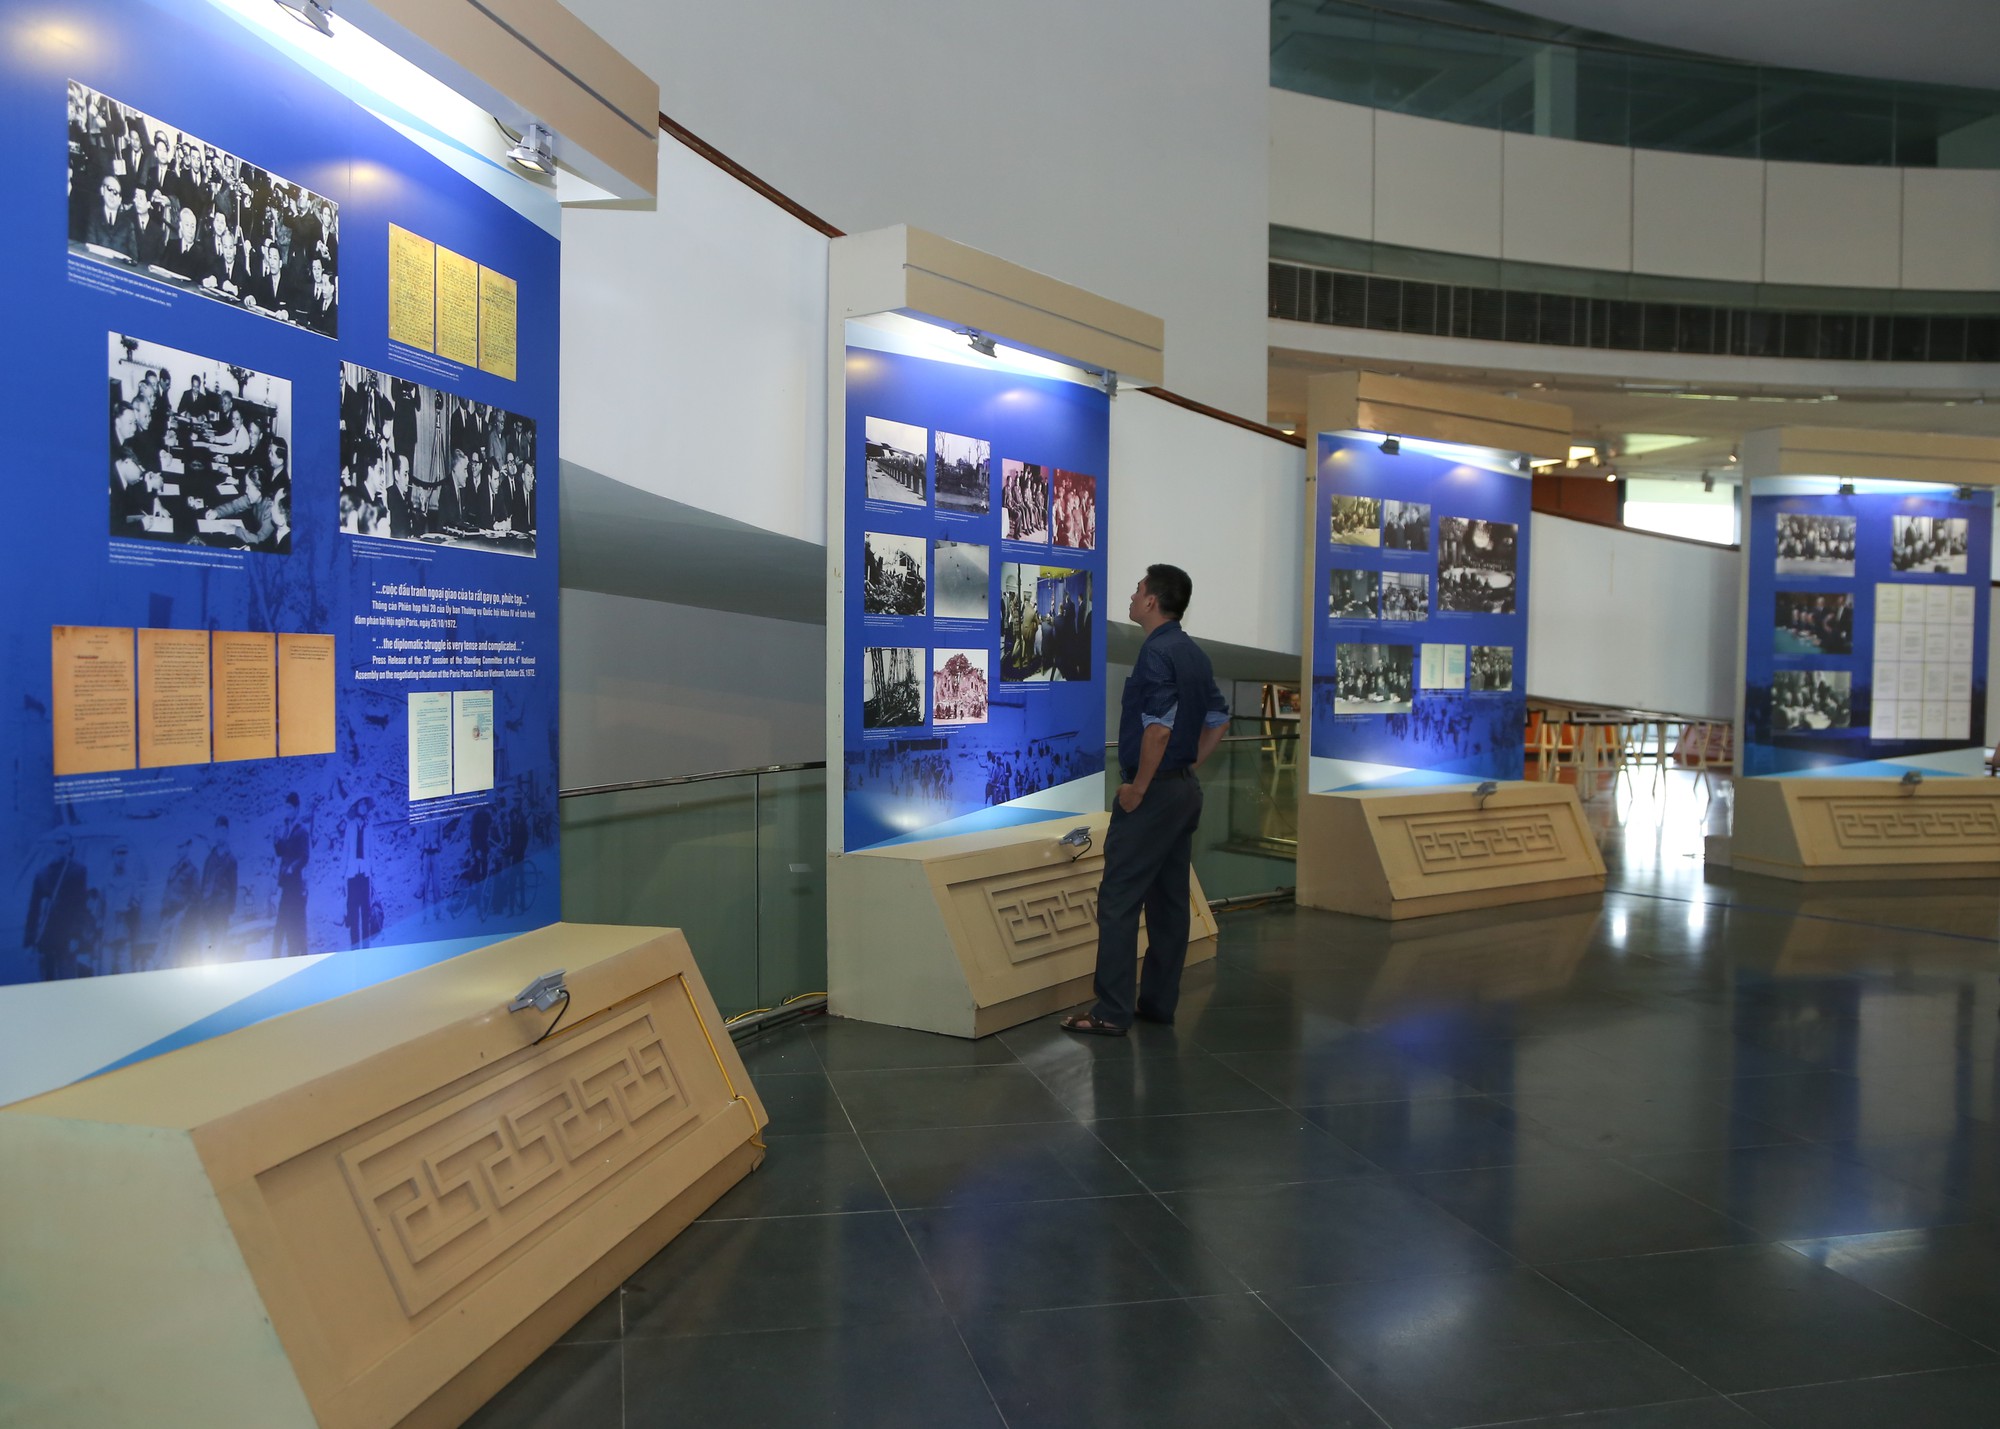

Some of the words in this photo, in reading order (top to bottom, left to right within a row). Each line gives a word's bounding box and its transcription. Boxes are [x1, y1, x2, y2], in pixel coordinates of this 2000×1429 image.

[398, 583, 410, 596] đấu
[411, 585, 427, 597] tranh
[428, 587, 444, 601] ngoại
[445, 588, 457, 601] giao
[458, 588, 467, 600] của
[468, 590, 474, 601] ta
[483, 593, 492, 604] gay
[372, 600, 387, 612] Thông
[388, 601, 398, 611] cáo
[398, 601, 411, 611] Phiên
[437, 604, 445, 613] của
[452, 606, 460, 614] ban
[386, 616, 395, 628] Hội
[395, 617, 405, 628] nghị
[406, 617, 420, 628] Paris,
[420, 618, 430, 629] ngày
[394, 638, 423, 652] diplomatic
[424, 639, 446, 652] struggle
[446, 639, 451, 650] is
[452, 641, 464, 652] very
[464, 640, 478, 651] tense
[478, 640, 488, 651] and
[372, 655, 386, 665] Press
[388, 655, 406, 665] Release
[408, 656, 413, 665] of
[414, 655, 422, 665] the
[432, 656, 449, 665] session
[450, 656, 455, 665] of
[463, 656, 481, 666] Standing
[482, 656, 503, 665] Committee
[504, 656, 508, 665] of
[521, 656, 536, 665] National
[355, 670, 379, 681] Assembly
[385, 670, 394, 679] the
[394, 670, 419, 681] negotiating
[419, 670, 438, 679] situation
[438, 670, 442, 679] at
[449, 669, 461, 678] Paris
[461, 669, 473, 678] Peace
[473, 669, 484, 678] Talks
[489, 669, 505, 678] Vietnam,
[505, 669, 519, 677] October
